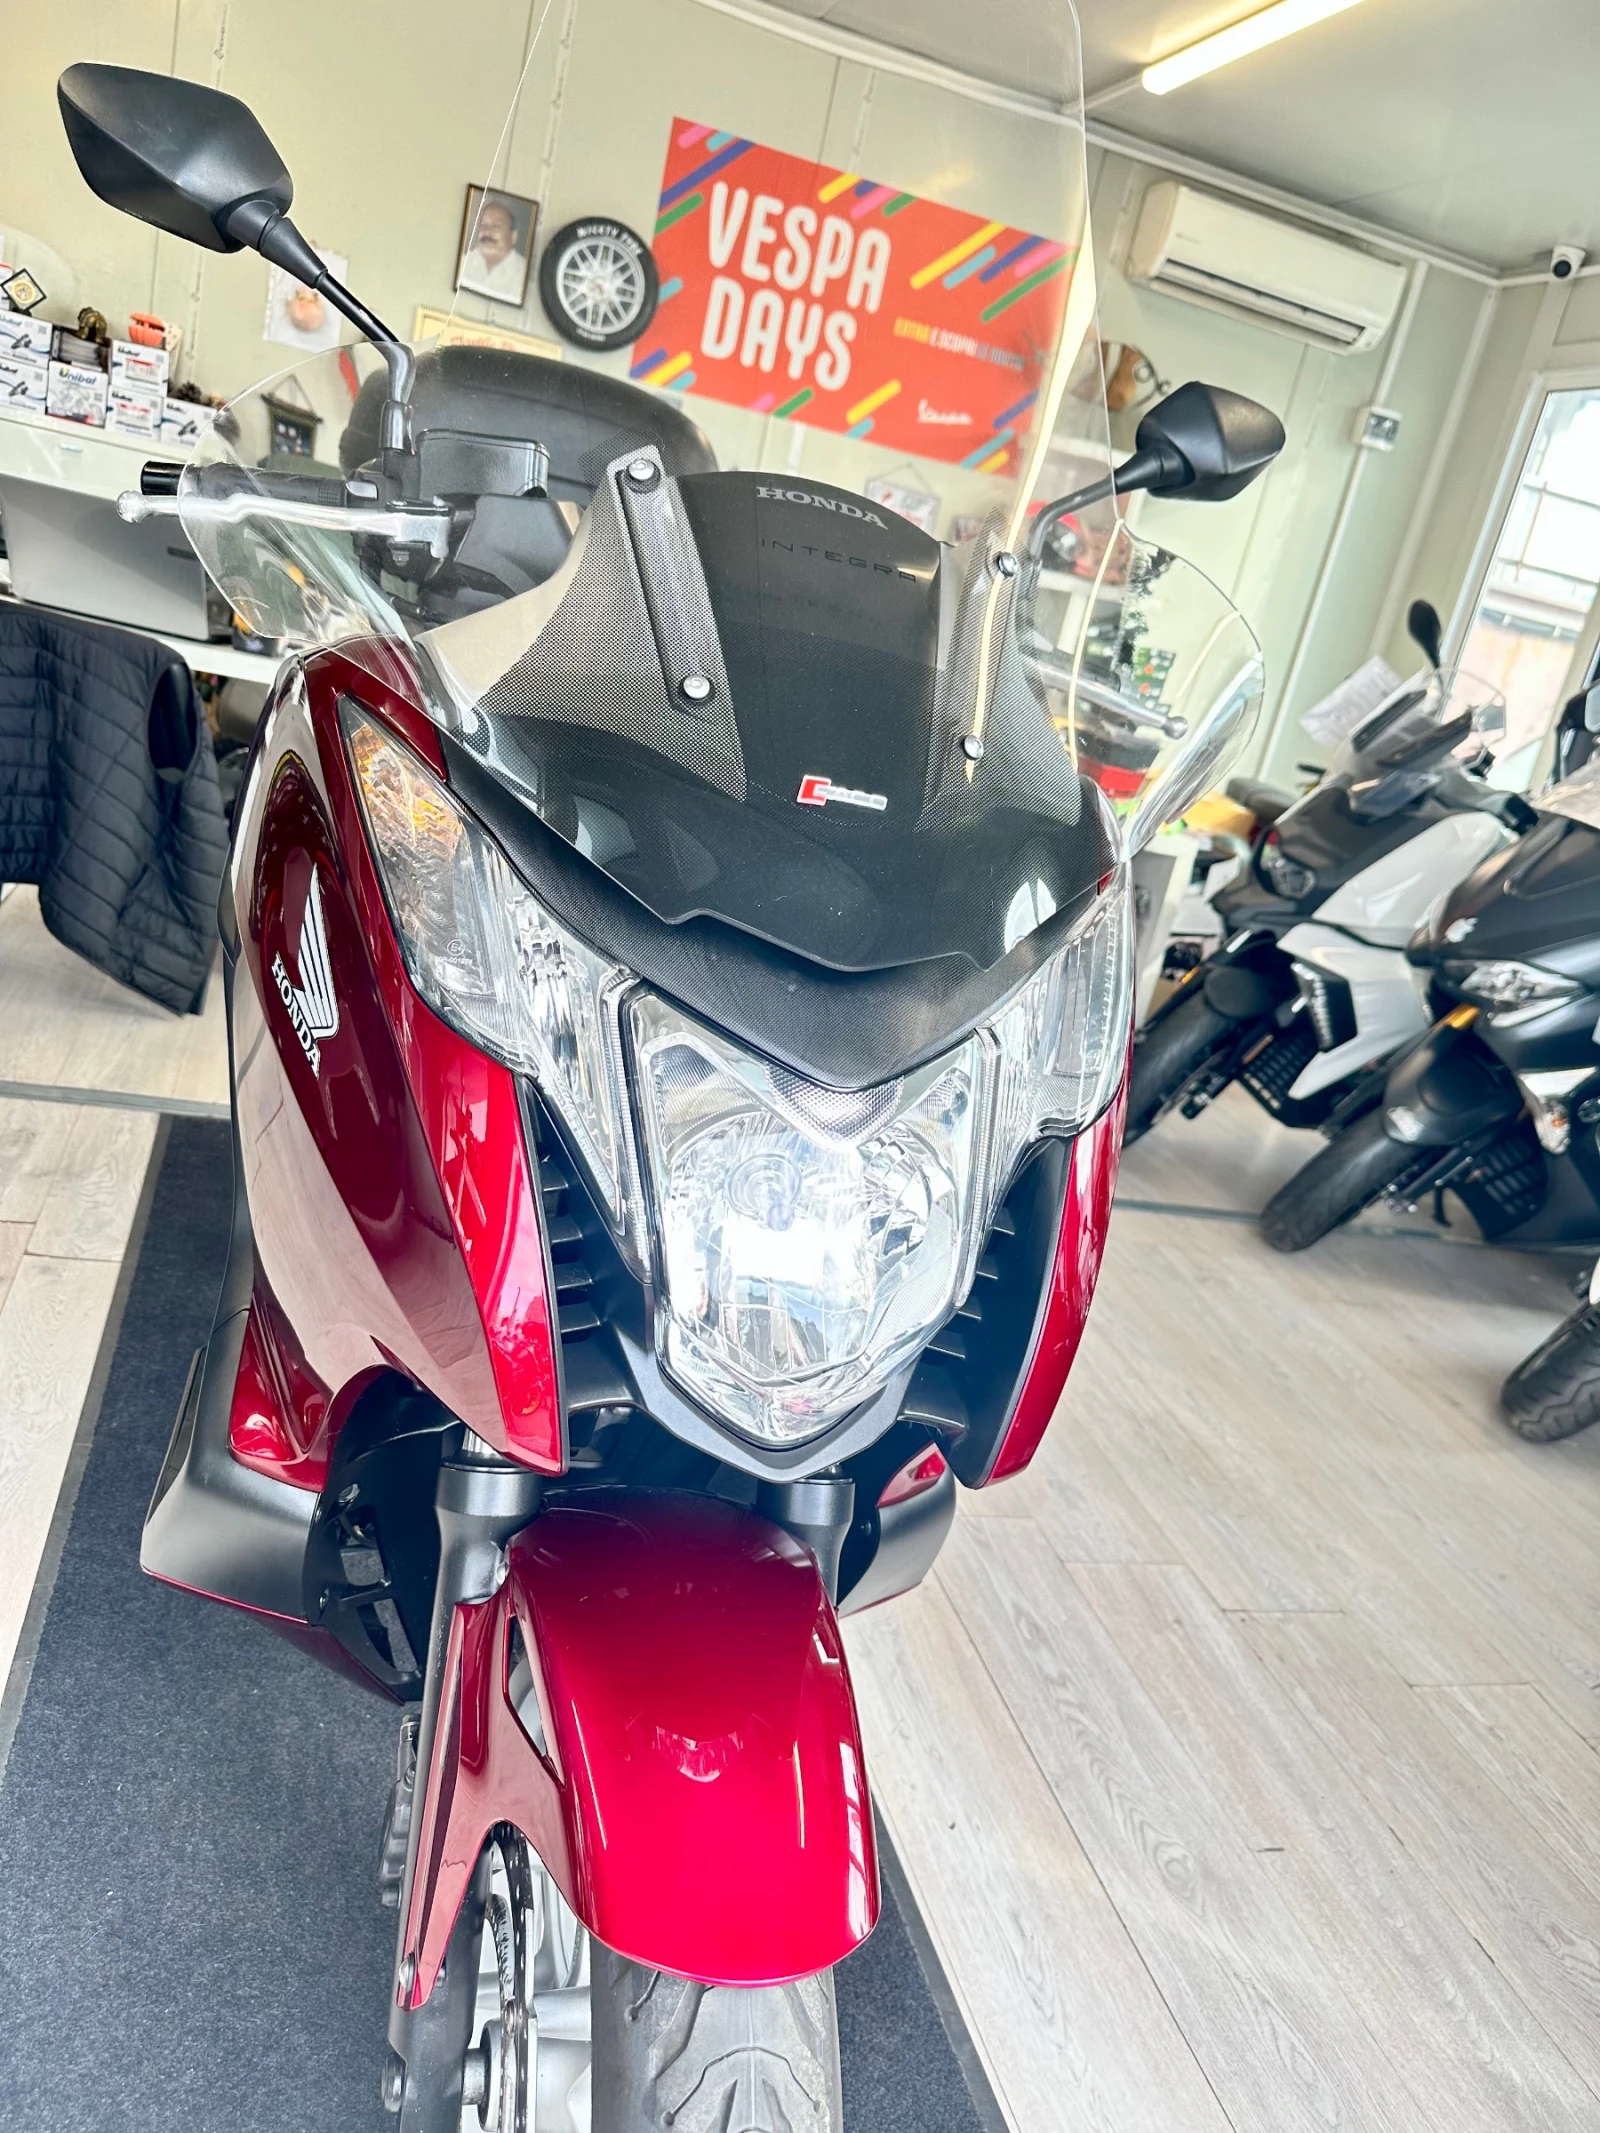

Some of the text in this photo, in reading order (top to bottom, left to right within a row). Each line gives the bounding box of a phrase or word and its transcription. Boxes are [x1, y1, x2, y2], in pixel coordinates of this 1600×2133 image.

[708, 182, 891, 313] VESPA
[701, 275, 857, 391] DAYS
[756, 485, 889, 529] HONDA
[760, 538, 917, 583] INTEGRA
[271, 951, 322, 1080] HONDA
